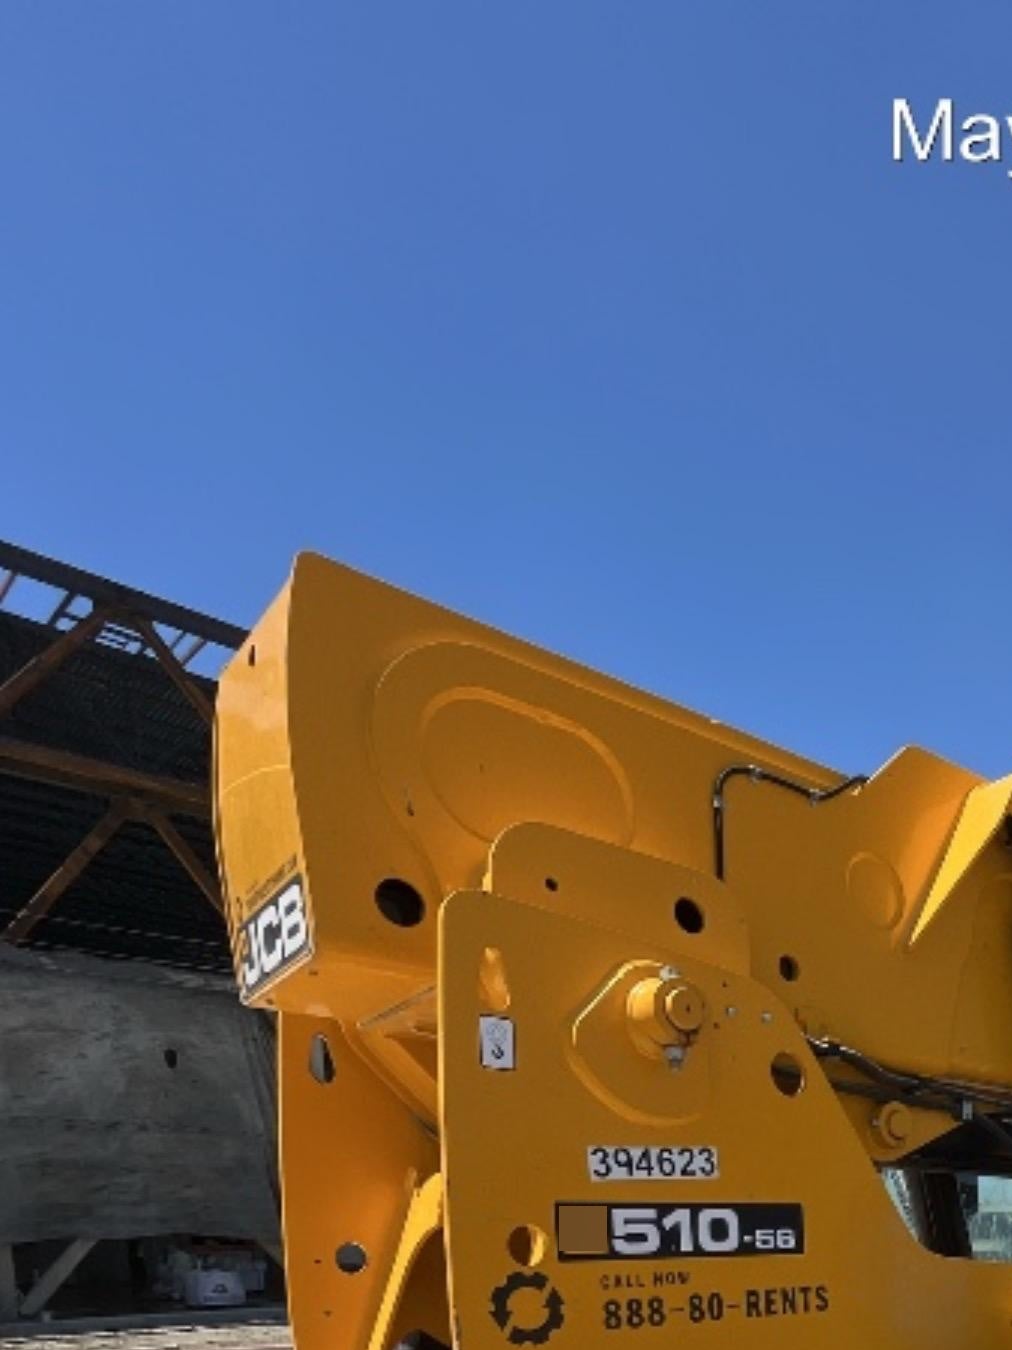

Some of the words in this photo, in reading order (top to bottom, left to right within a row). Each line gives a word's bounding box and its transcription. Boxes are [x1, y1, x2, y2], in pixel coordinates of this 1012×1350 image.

[244, 883, 307, 989] JCB
[590, 1147, 716, 1178] 394623
[600, 1273, 646, 1290] CALL
[604, 1283, 830, 1330] 888-80-RENTS
